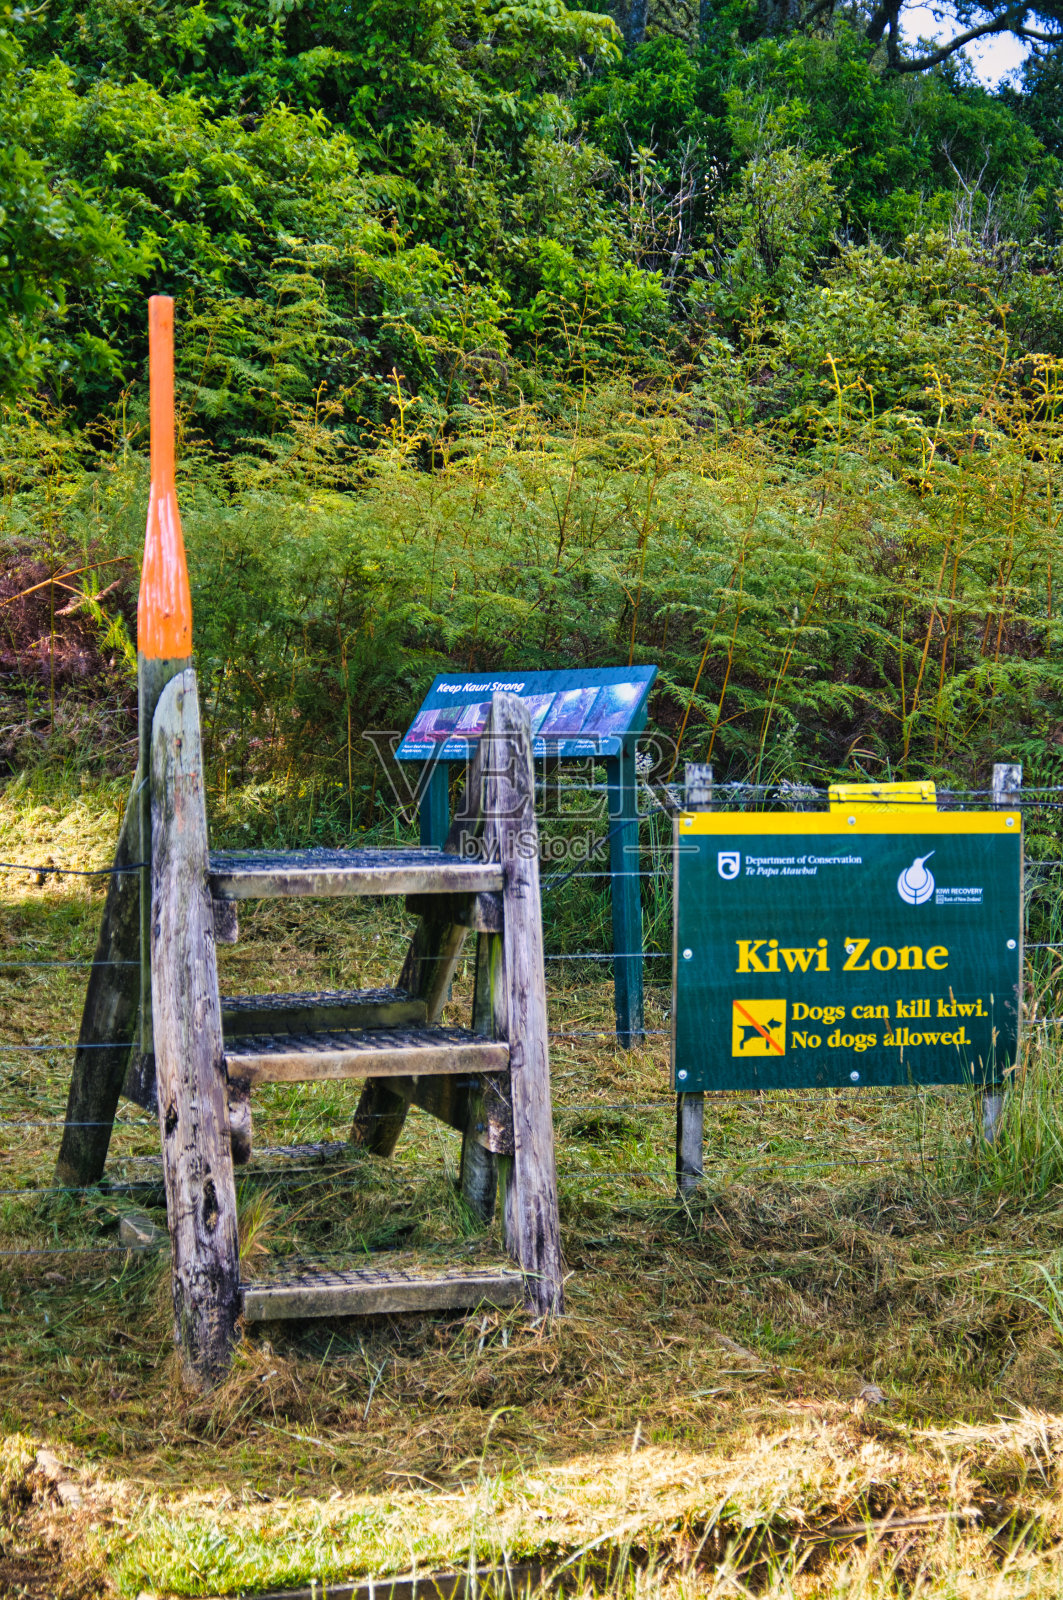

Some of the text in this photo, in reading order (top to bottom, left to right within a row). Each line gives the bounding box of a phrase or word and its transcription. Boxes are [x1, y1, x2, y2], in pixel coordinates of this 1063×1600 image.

[436, 682, 525, 694] Keep Kauri Strong
[745, 855, 862, 866] Department of Conservation
[745, 867, 755, 875] Te
[756, 867, 779, 877] Papa
[735, 937, 949, 973] Kiwi Zone
[791, 999, 989, 1024] Dogs can kill kiwi.
[791, 1026, 972, 1052] No dogs allowed.
